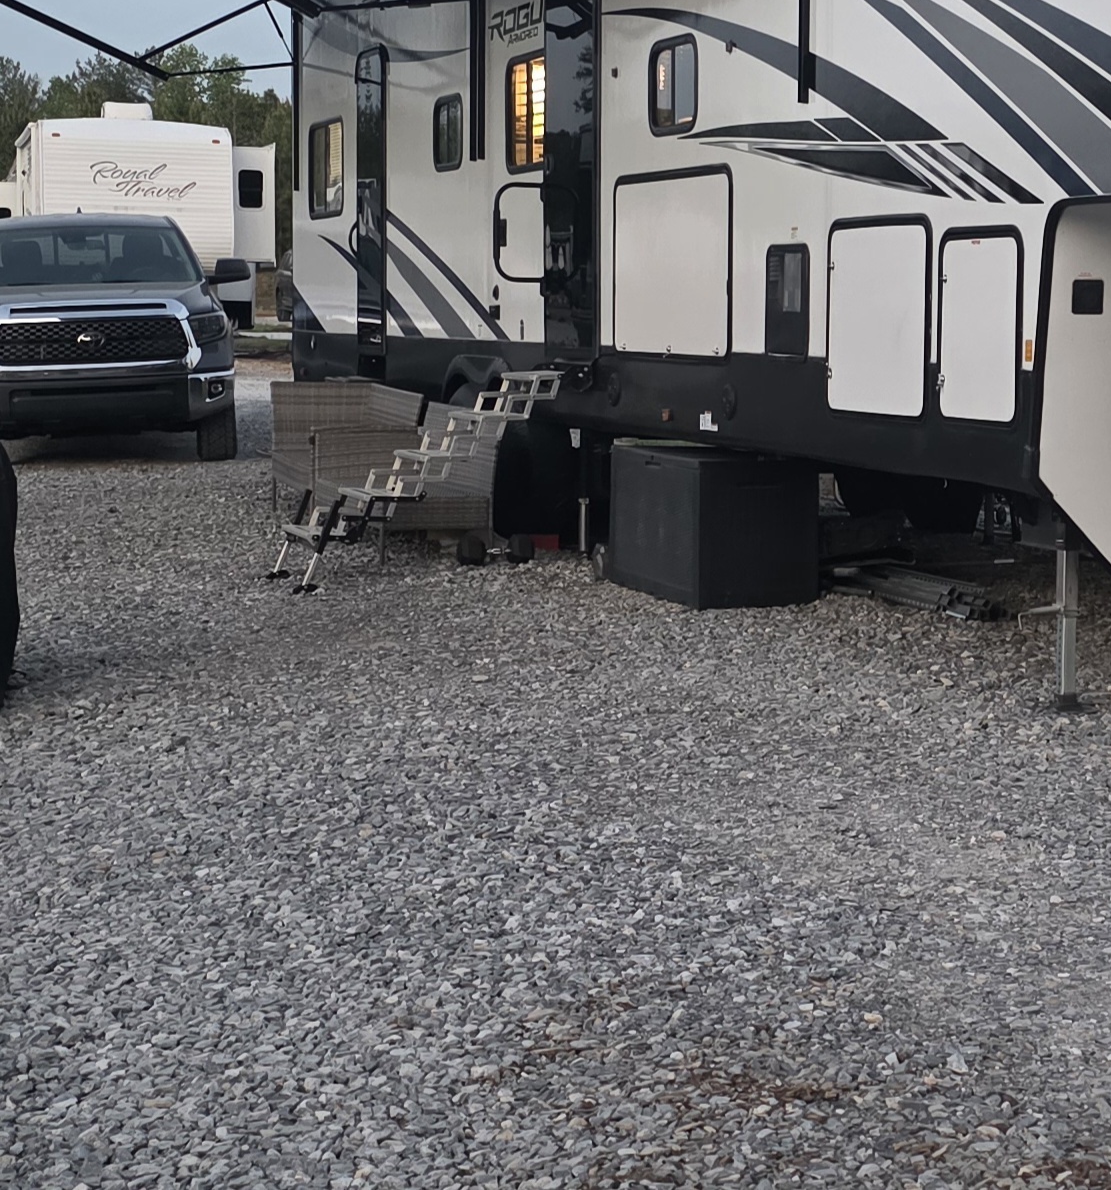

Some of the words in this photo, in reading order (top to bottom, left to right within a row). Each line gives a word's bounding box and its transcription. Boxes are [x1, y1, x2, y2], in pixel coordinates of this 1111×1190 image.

[507, 26, 538, 48] ARMORED
[90, 161, 168, 185] Royal
[108, 180, 197, 198] Travel
